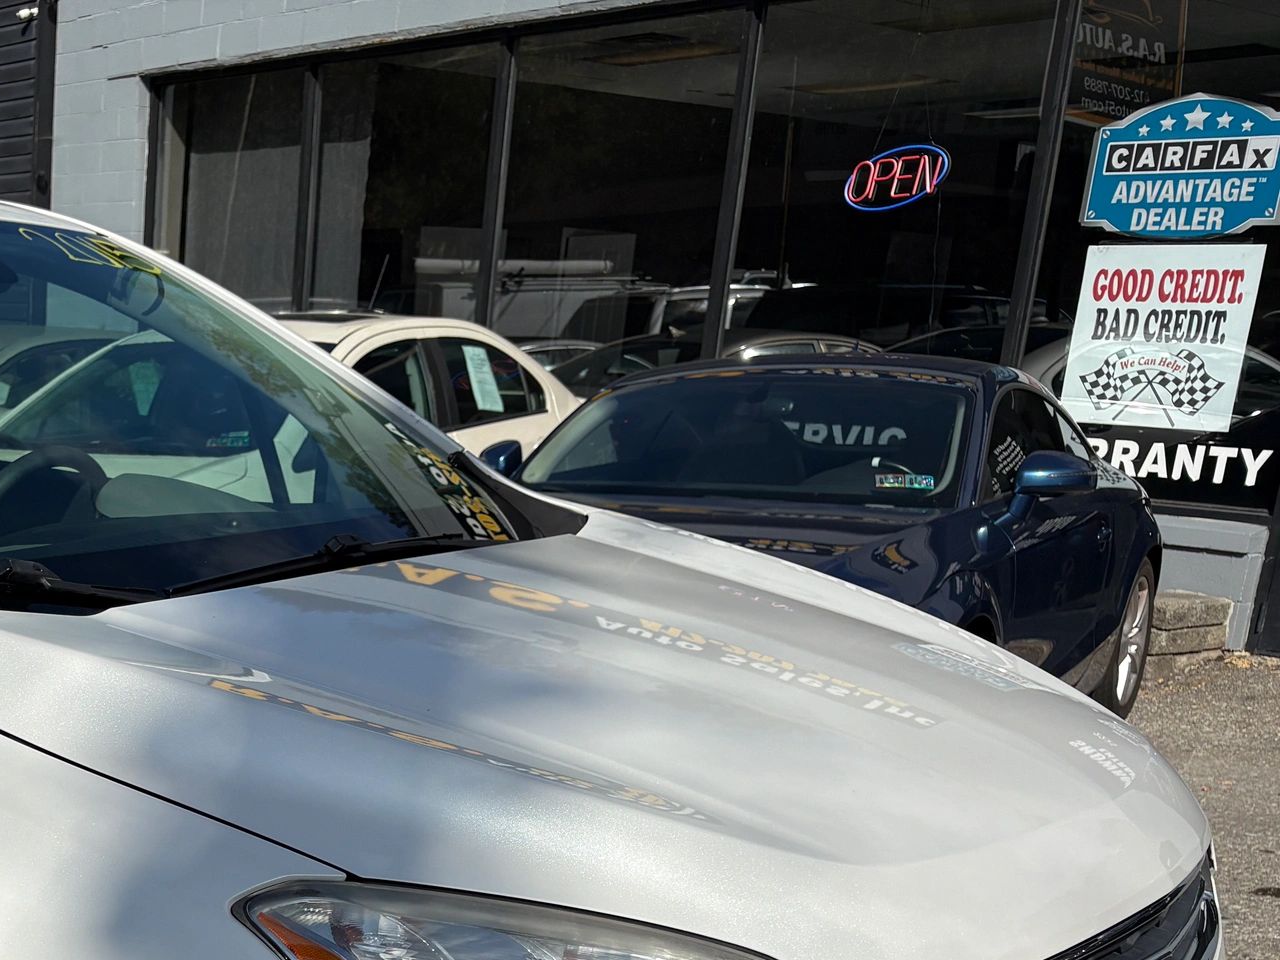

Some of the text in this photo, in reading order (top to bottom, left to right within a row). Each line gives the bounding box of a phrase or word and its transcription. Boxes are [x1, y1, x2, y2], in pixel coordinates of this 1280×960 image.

[1111, 143, 1272, 170] CARFAX
[849, 154, 942, 203] OPEN
[1130, 207, 1224, 231] DEALER
[1093, 268, 1245, 304] GOOD CREDIT.
[1091, 307, 1227, 344] BAD CREDIT.
[1120, 356, 1186, 373] We Can Help!
